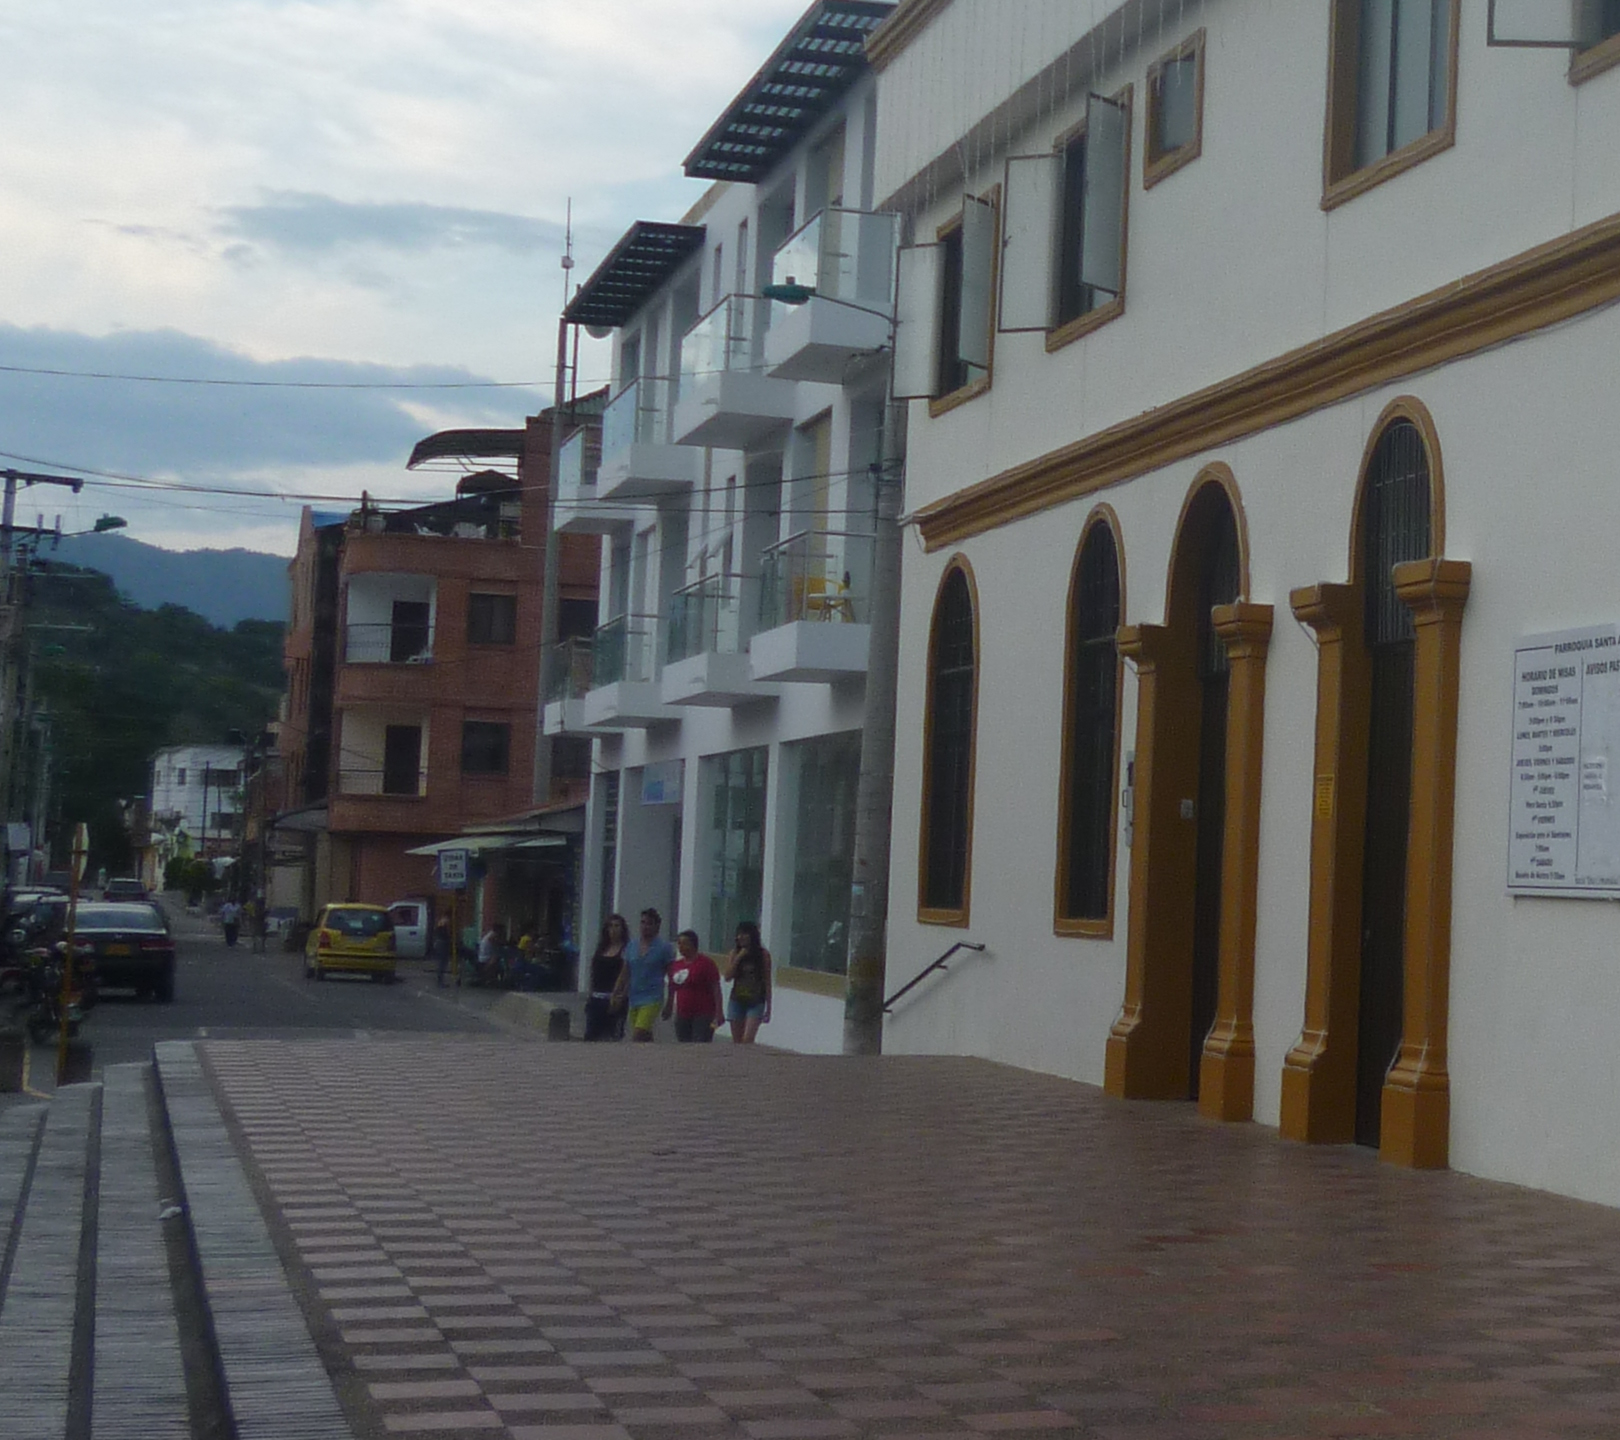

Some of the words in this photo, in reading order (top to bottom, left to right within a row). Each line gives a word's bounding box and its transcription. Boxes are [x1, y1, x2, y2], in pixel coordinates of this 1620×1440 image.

[1554, 639, 1593, 654] PARROQUIA
[1594, 636, 1616, 648] SANTA
[1548, 668, 1557, 680] DE
[1586, 661, 1608, 675] AVISOS
